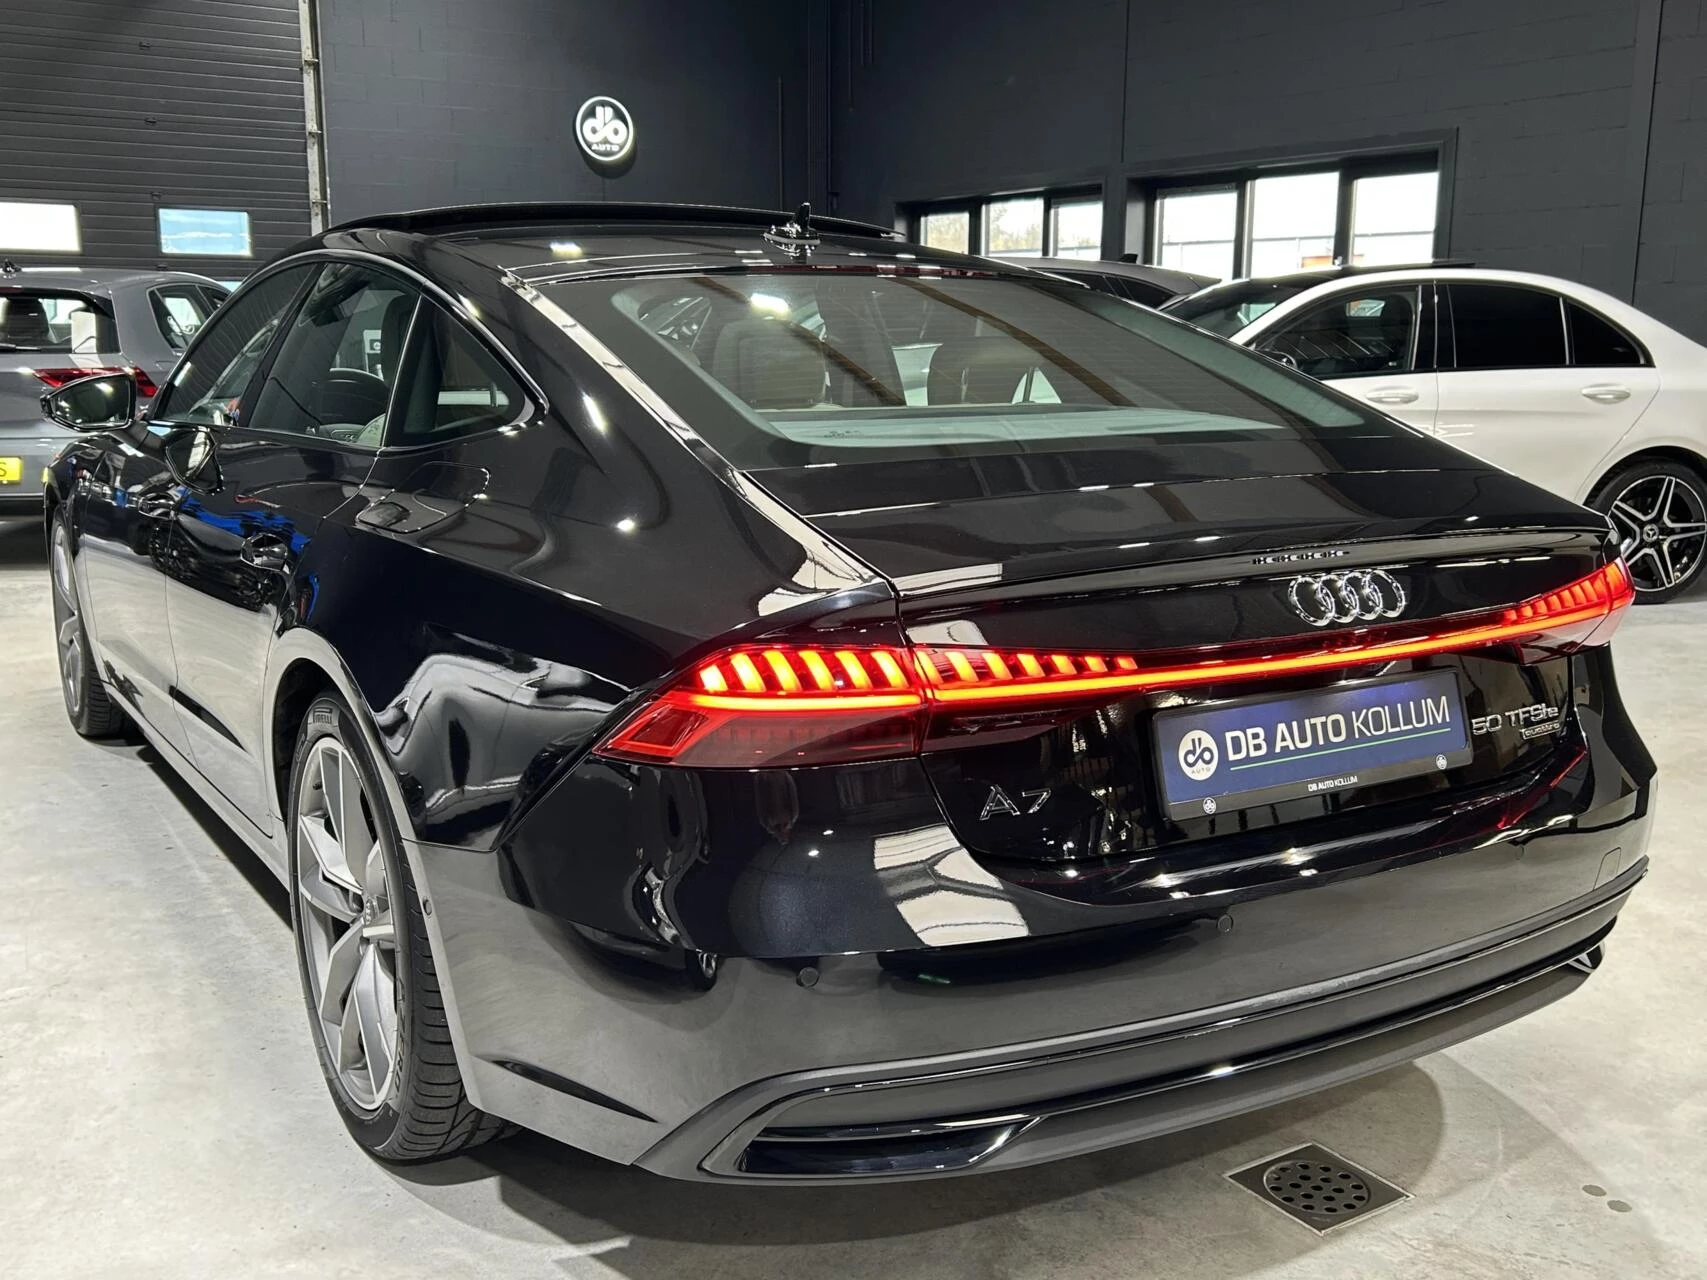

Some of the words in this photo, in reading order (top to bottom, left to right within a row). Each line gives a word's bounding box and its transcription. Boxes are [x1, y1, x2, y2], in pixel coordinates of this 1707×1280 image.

[591, 143, 620, 152] AUTO
[1225, 726, 1268, 761] DB
[1275, 713, 1347, 753] AUTO
[1351, 695, 1450, 739] KOLLUM
[1471, 714, 1502, 736] 50
[1191, 767, 1211, 775] AUTO
[1307, 783, 1318, 792] DB
[1318, 780, 1334, 790] AUTO
[1334, 775, 1358, 787] KOLLUM
[979, 784, 1051, 820] A7
